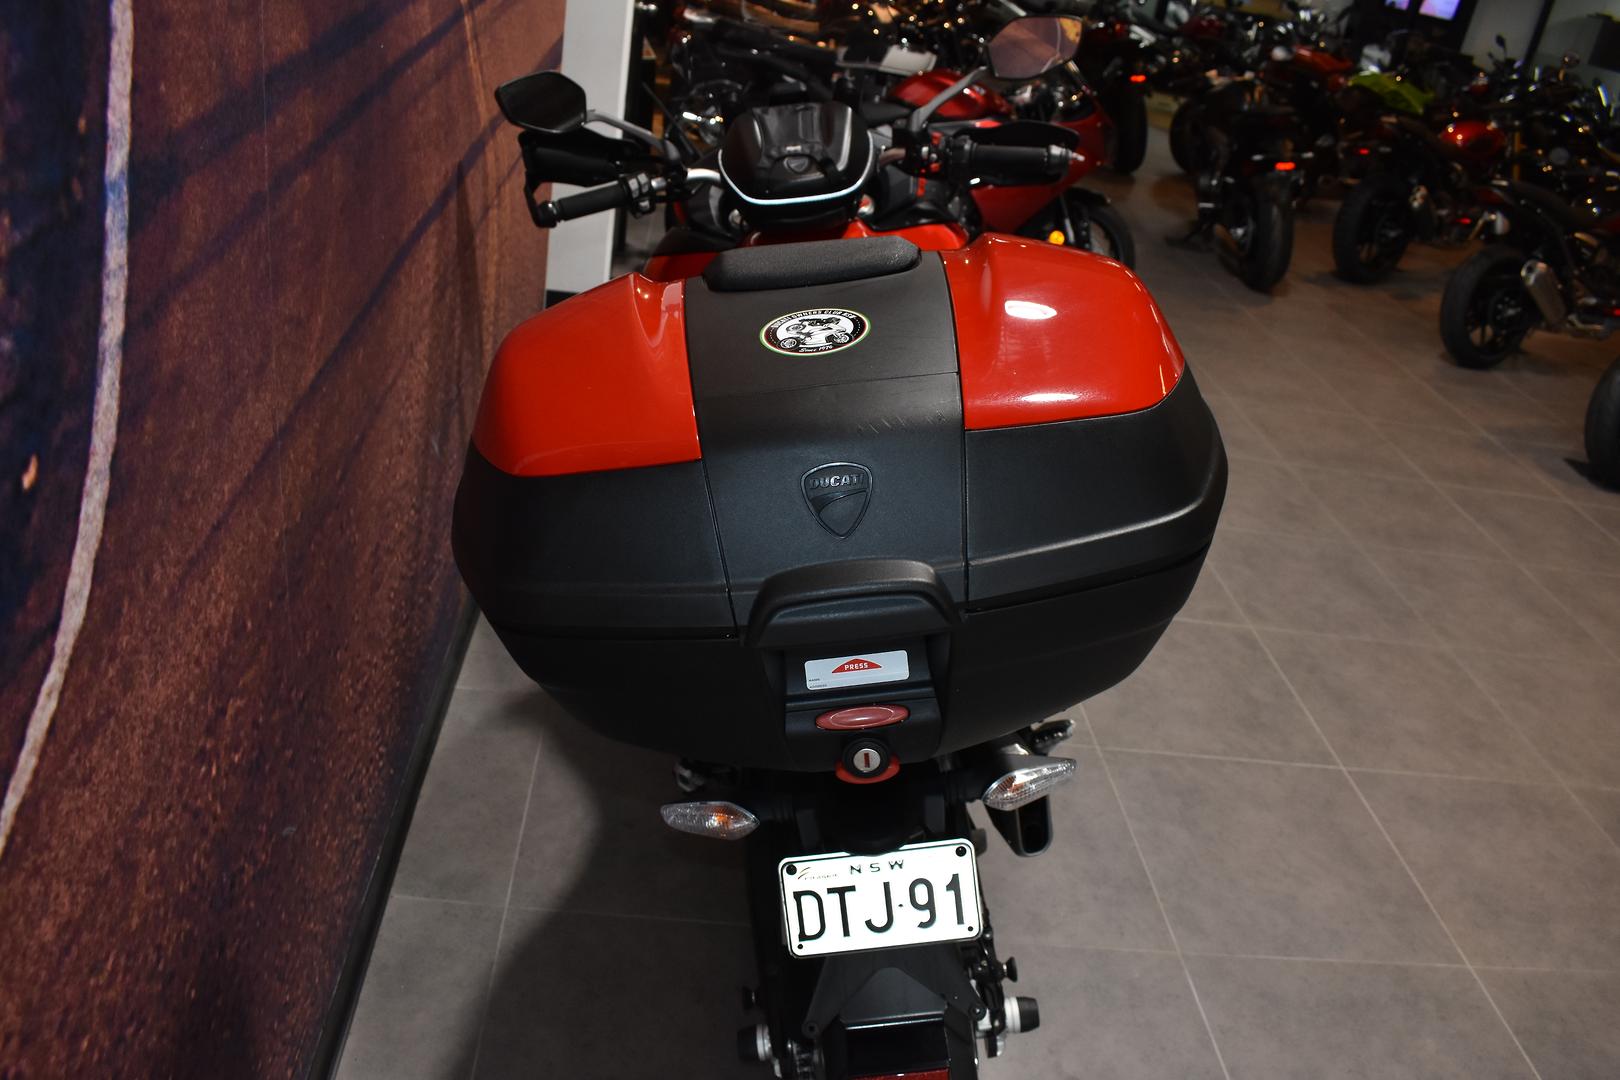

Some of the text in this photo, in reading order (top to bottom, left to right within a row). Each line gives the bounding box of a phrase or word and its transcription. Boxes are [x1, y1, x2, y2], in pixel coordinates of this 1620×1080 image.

[809, 474, 865, 489] DUCATI
[844, 662, 869, 671] PRESS
[850, 859, 904, 875] NSW
